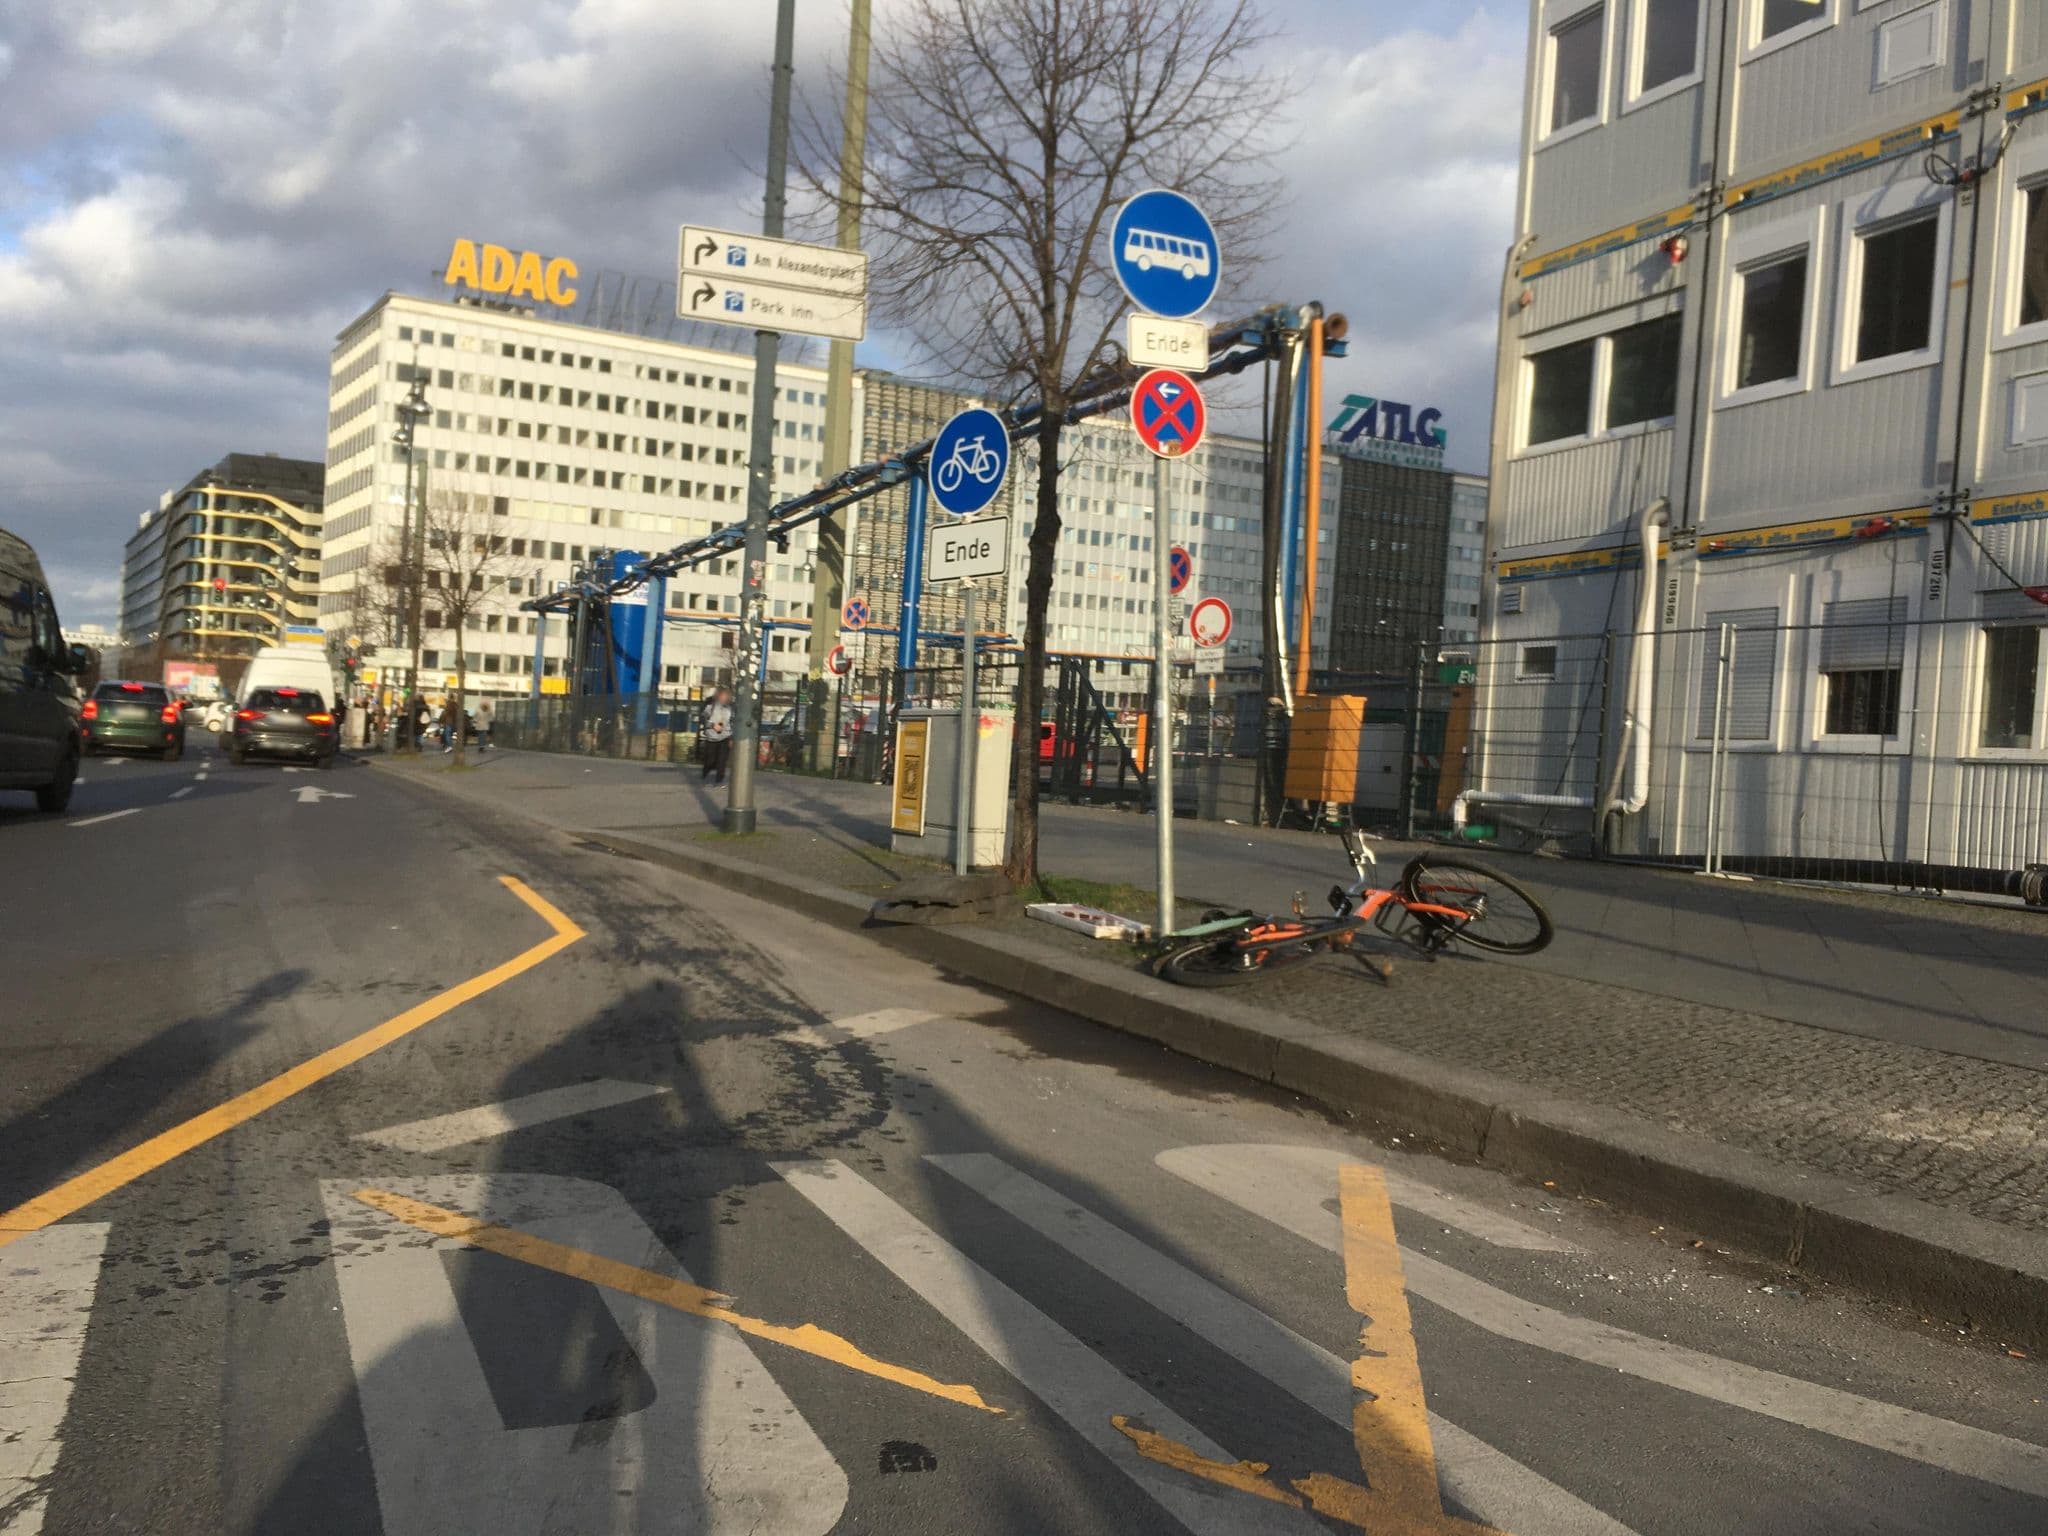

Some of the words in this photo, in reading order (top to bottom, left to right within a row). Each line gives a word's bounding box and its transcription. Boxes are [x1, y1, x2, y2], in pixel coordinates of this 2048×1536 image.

[753, 253, 771, 268] Am
[444, 238, 578, 306] ADAC
[750, 297, 785, 316] Park
[1146, 331, 1190, 354] Ende
[1992, 497, 2044, 515] Einfach
[944, 537, 990, 563] Ende
